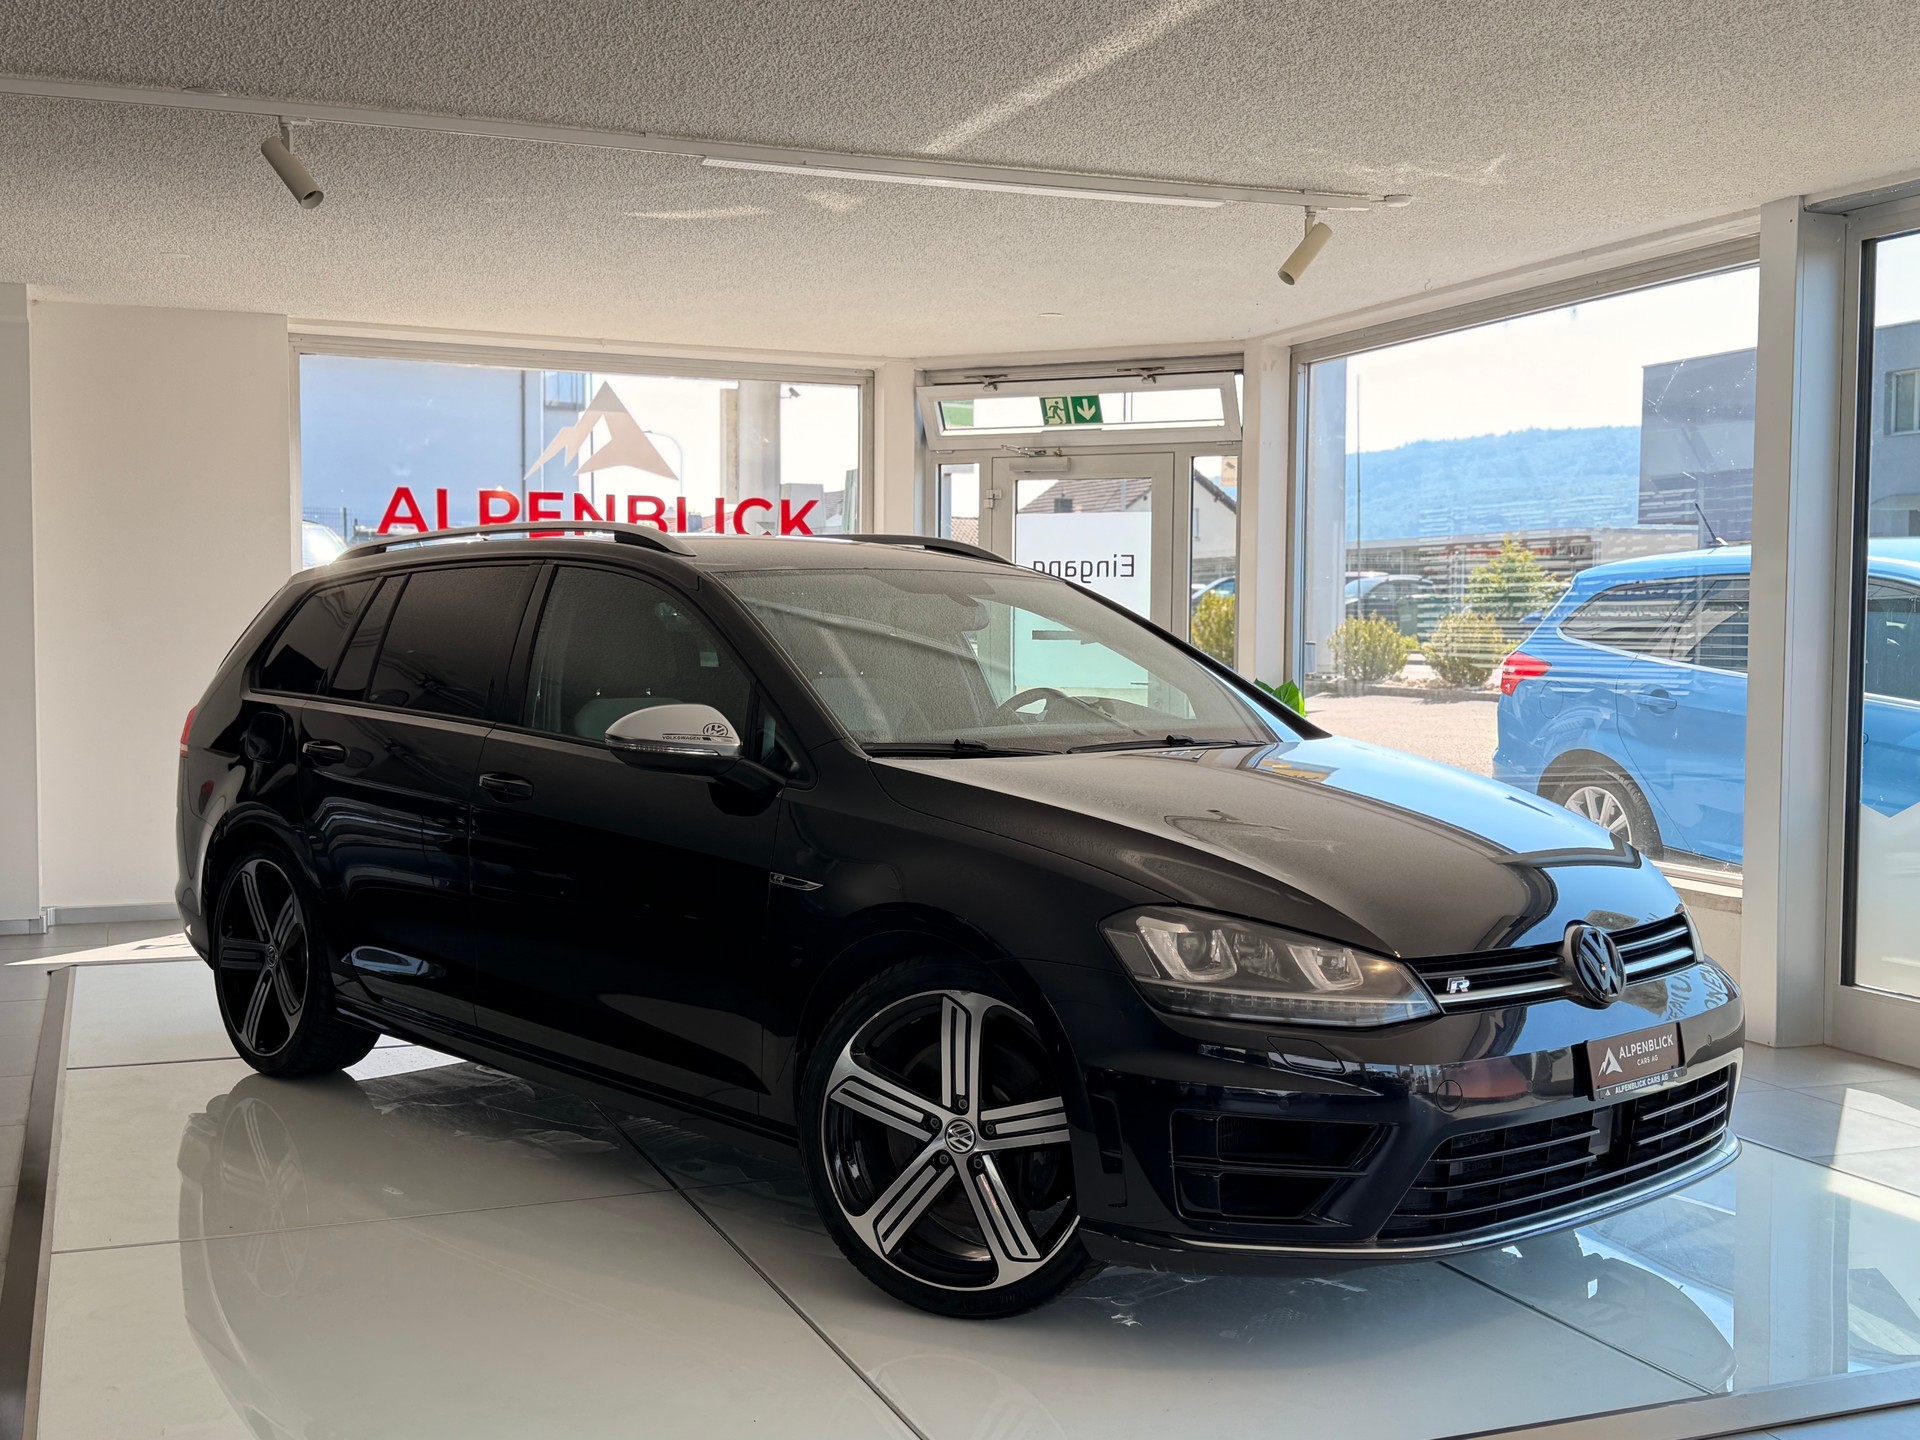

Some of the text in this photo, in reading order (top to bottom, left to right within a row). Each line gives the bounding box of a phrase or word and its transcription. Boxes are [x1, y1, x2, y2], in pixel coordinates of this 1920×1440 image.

[1447, 976, 1470, 993] R
[1619, 1034, 1674, 1059] ALPENBLICK
[1636, 1054, 1659, 1066] CARS AG
[1615, 1073, 1669, 1094] ALPENBLICK CARS AG
